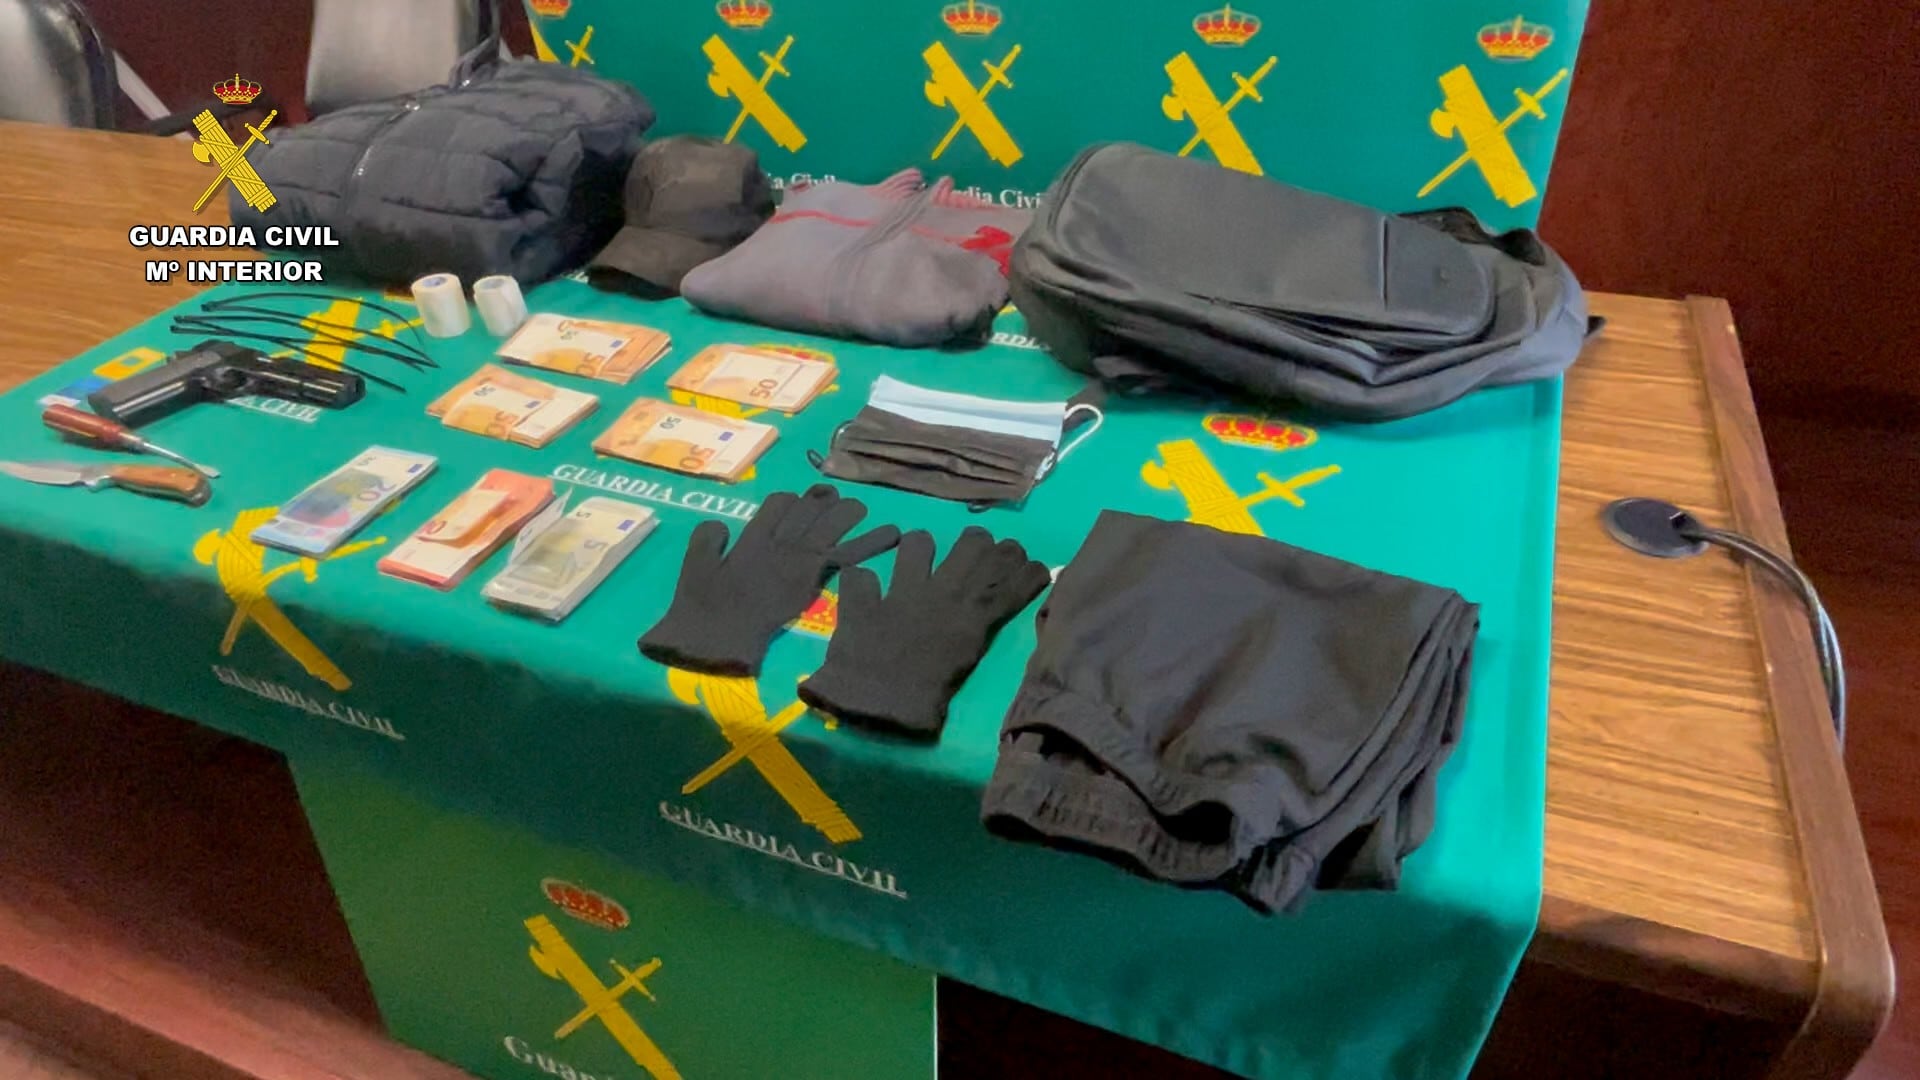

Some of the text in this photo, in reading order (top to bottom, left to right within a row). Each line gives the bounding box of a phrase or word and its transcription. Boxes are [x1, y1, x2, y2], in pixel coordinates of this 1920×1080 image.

[1000, 189, 1041, 209] Civi
[750, 378, 780, 400] 50
[679, 444, 716, 471] 50
[552, 463, 762, 521] GUARDIA CIVIL
[327, 701, 406, 742] CIVIL
[658, 800, 908, 899] GUARDIA CIVIL
